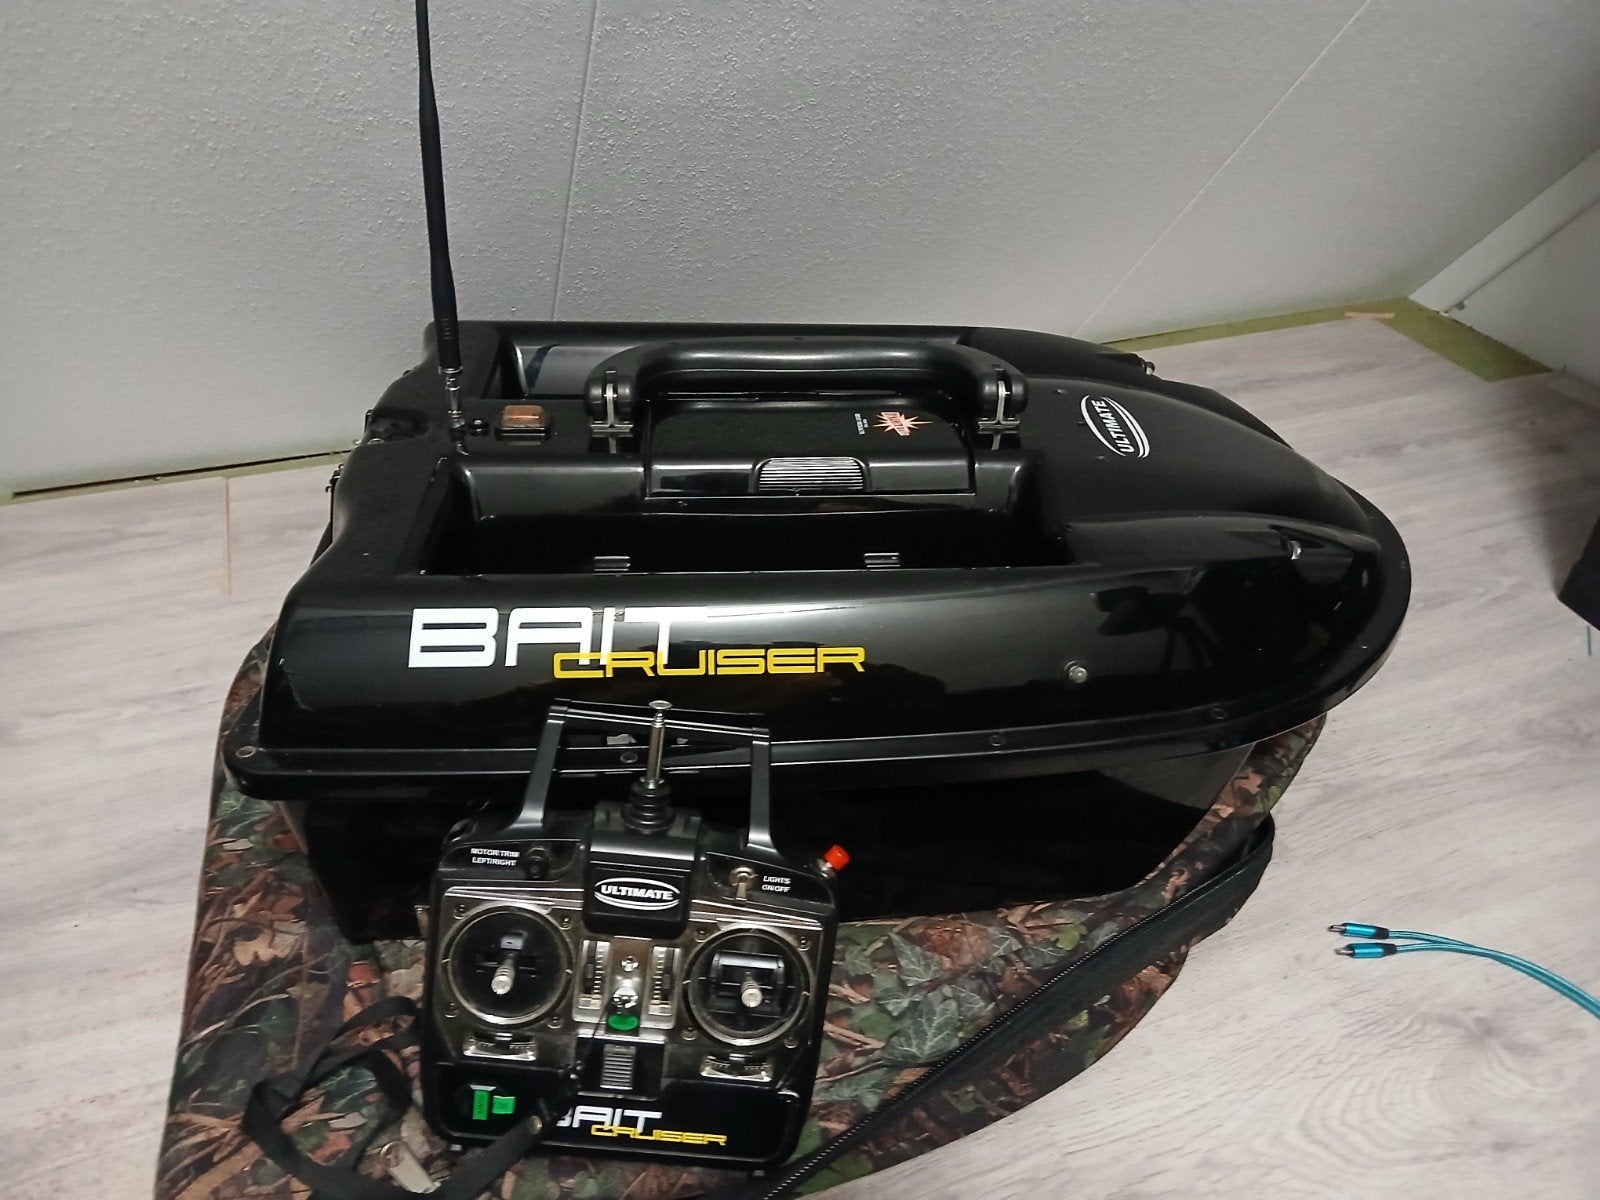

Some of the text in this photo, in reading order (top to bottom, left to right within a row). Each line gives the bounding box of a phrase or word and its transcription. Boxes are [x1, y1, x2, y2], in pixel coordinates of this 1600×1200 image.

[1091, 400, 1135, 453] ULTIMATE
[408, 606, 708, 668] BAIT
[553, 647, 866, 678] CRUISER
[601, 885, 674, 900] ULTIMATE
[763, 876, 791, 884] LIGHTS
[591, 1124, 727, 1146] CRUISER
